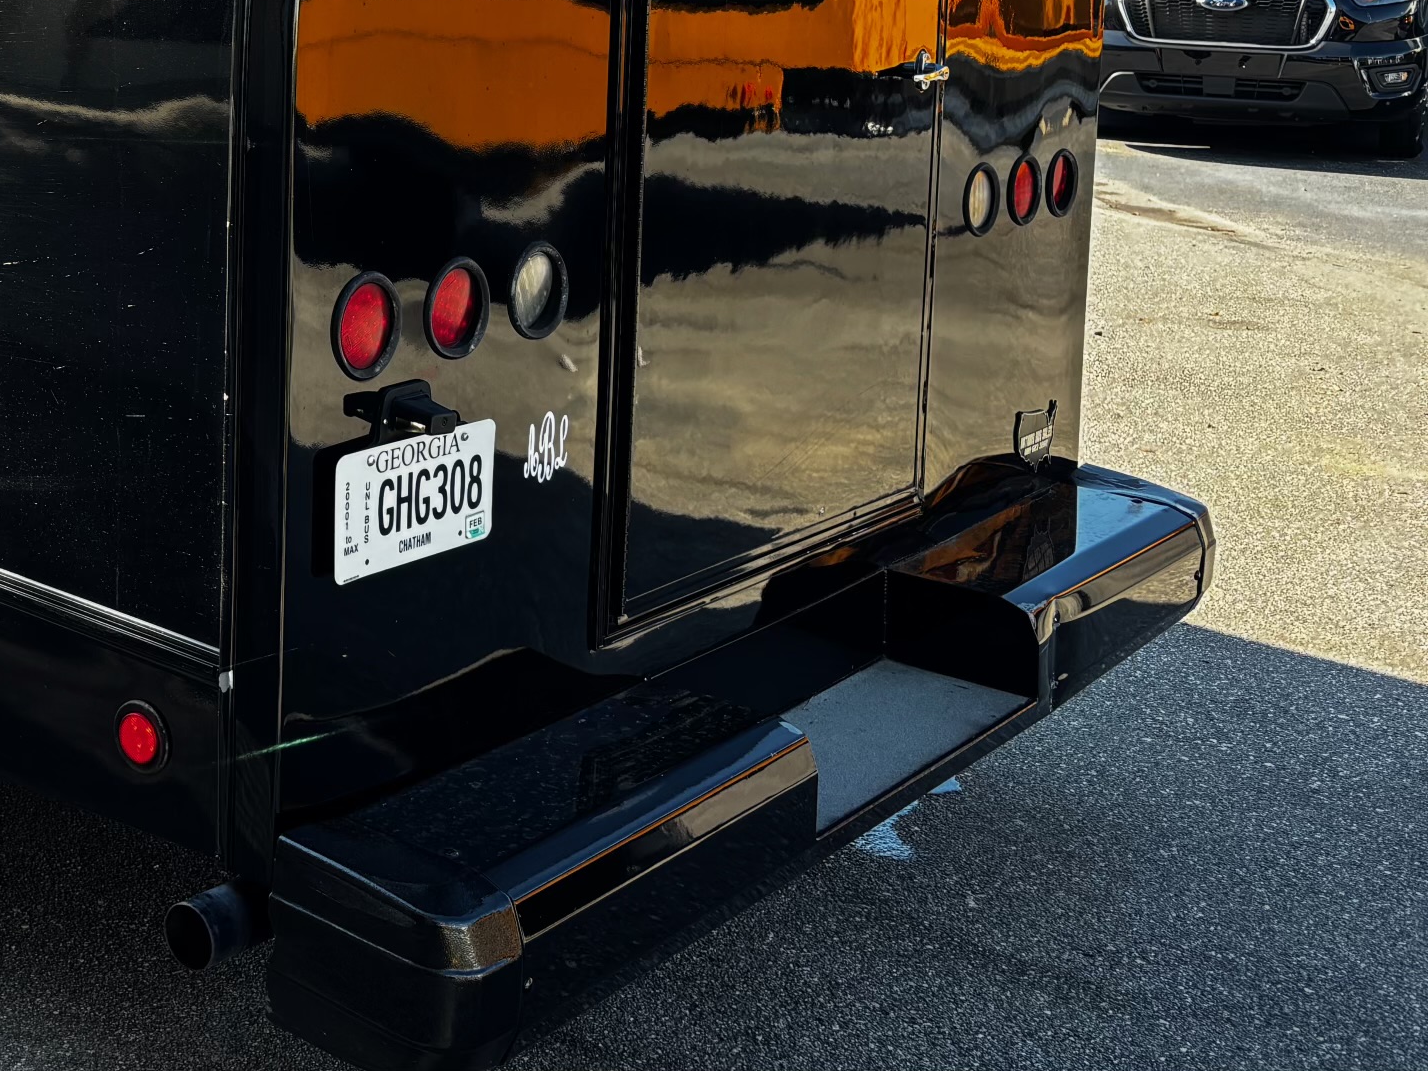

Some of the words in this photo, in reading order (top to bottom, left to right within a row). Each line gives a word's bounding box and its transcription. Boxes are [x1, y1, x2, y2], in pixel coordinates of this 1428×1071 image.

[375, 433, 461, 473] GEORGIA
[378, 454, 483, 536] GHG308
[469, 516, 483, 529] FEB
[343, 543, 359, 557] MAX
[398, 531, 432, 554] CHATHAM
